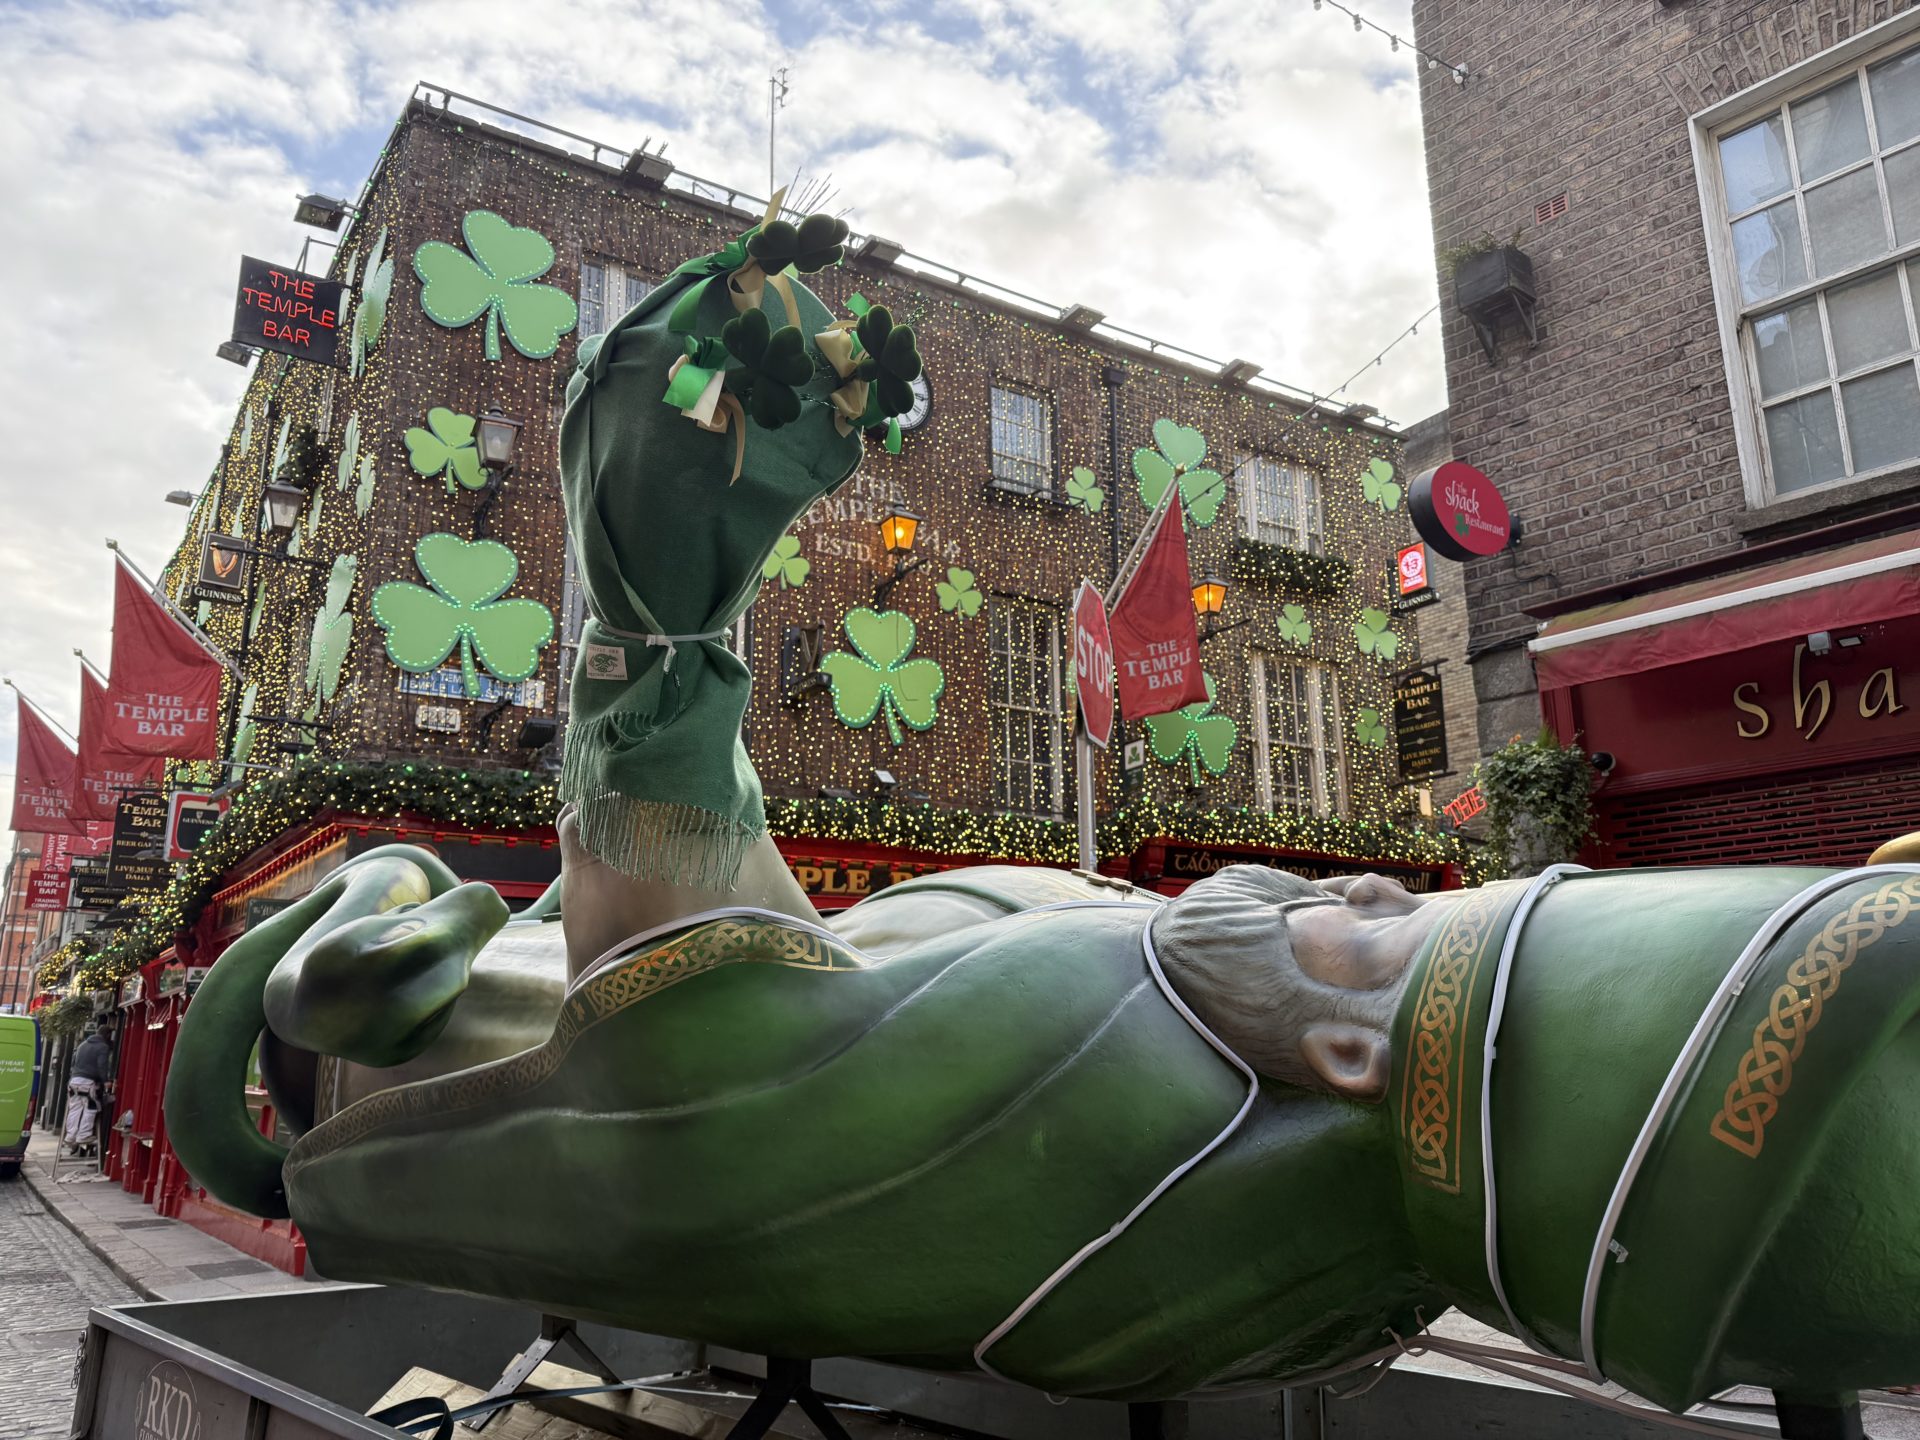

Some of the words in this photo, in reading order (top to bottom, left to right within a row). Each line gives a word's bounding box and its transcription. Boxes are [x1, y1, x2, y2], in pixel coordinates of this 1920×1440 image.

[269, 270, 315, 299] THE
[242, 287, 335, 328] TEMPLE
[263, 320, 309, 347] BAR
[854, 473, 904, 504] THE
[797, 497, 895, 529] EMPL
[1464, 514, 1505, 537] Restaurant
[194, 586, 243, 603] GUINNESS
[1399, 593, 1433, 610] GUINNESS
[1146, 639, 1178, 657] THE
[1078, 624, 1114, 698] STOP
[1148, 669, 1184, 690] BAR
[1410, 676, 1424, 685] THE
[1396, 681, 1440, 700] TEMPLE
[145, 693, 184, 707] THE
[1406, 696, 1431, 710] BAR
[114, 702, 209, 722] TEMPLE
[137, 722, 185, 737] BAR
[1415, 720, 1441, 731] GARDEN
[1402, 751, 1418, 761] LIVE
[1418, 747, 1441, 757] MUSIC
[104, 770, 135, 782] THE
[40, 786, 64, 798] THE
[97, 793, 119, 805] BA
[18, 794, 74, 810] TEMPL
[120, 803, 168, 817] TEMPL
[1443, 786, 1488, 828] THE
[34, 806, 66, 819] BAR
[131, 816, 161, 828] BAR
[115, 865, 134, 873] LIVE
[33, 880, 66, 888] TEMPLE
